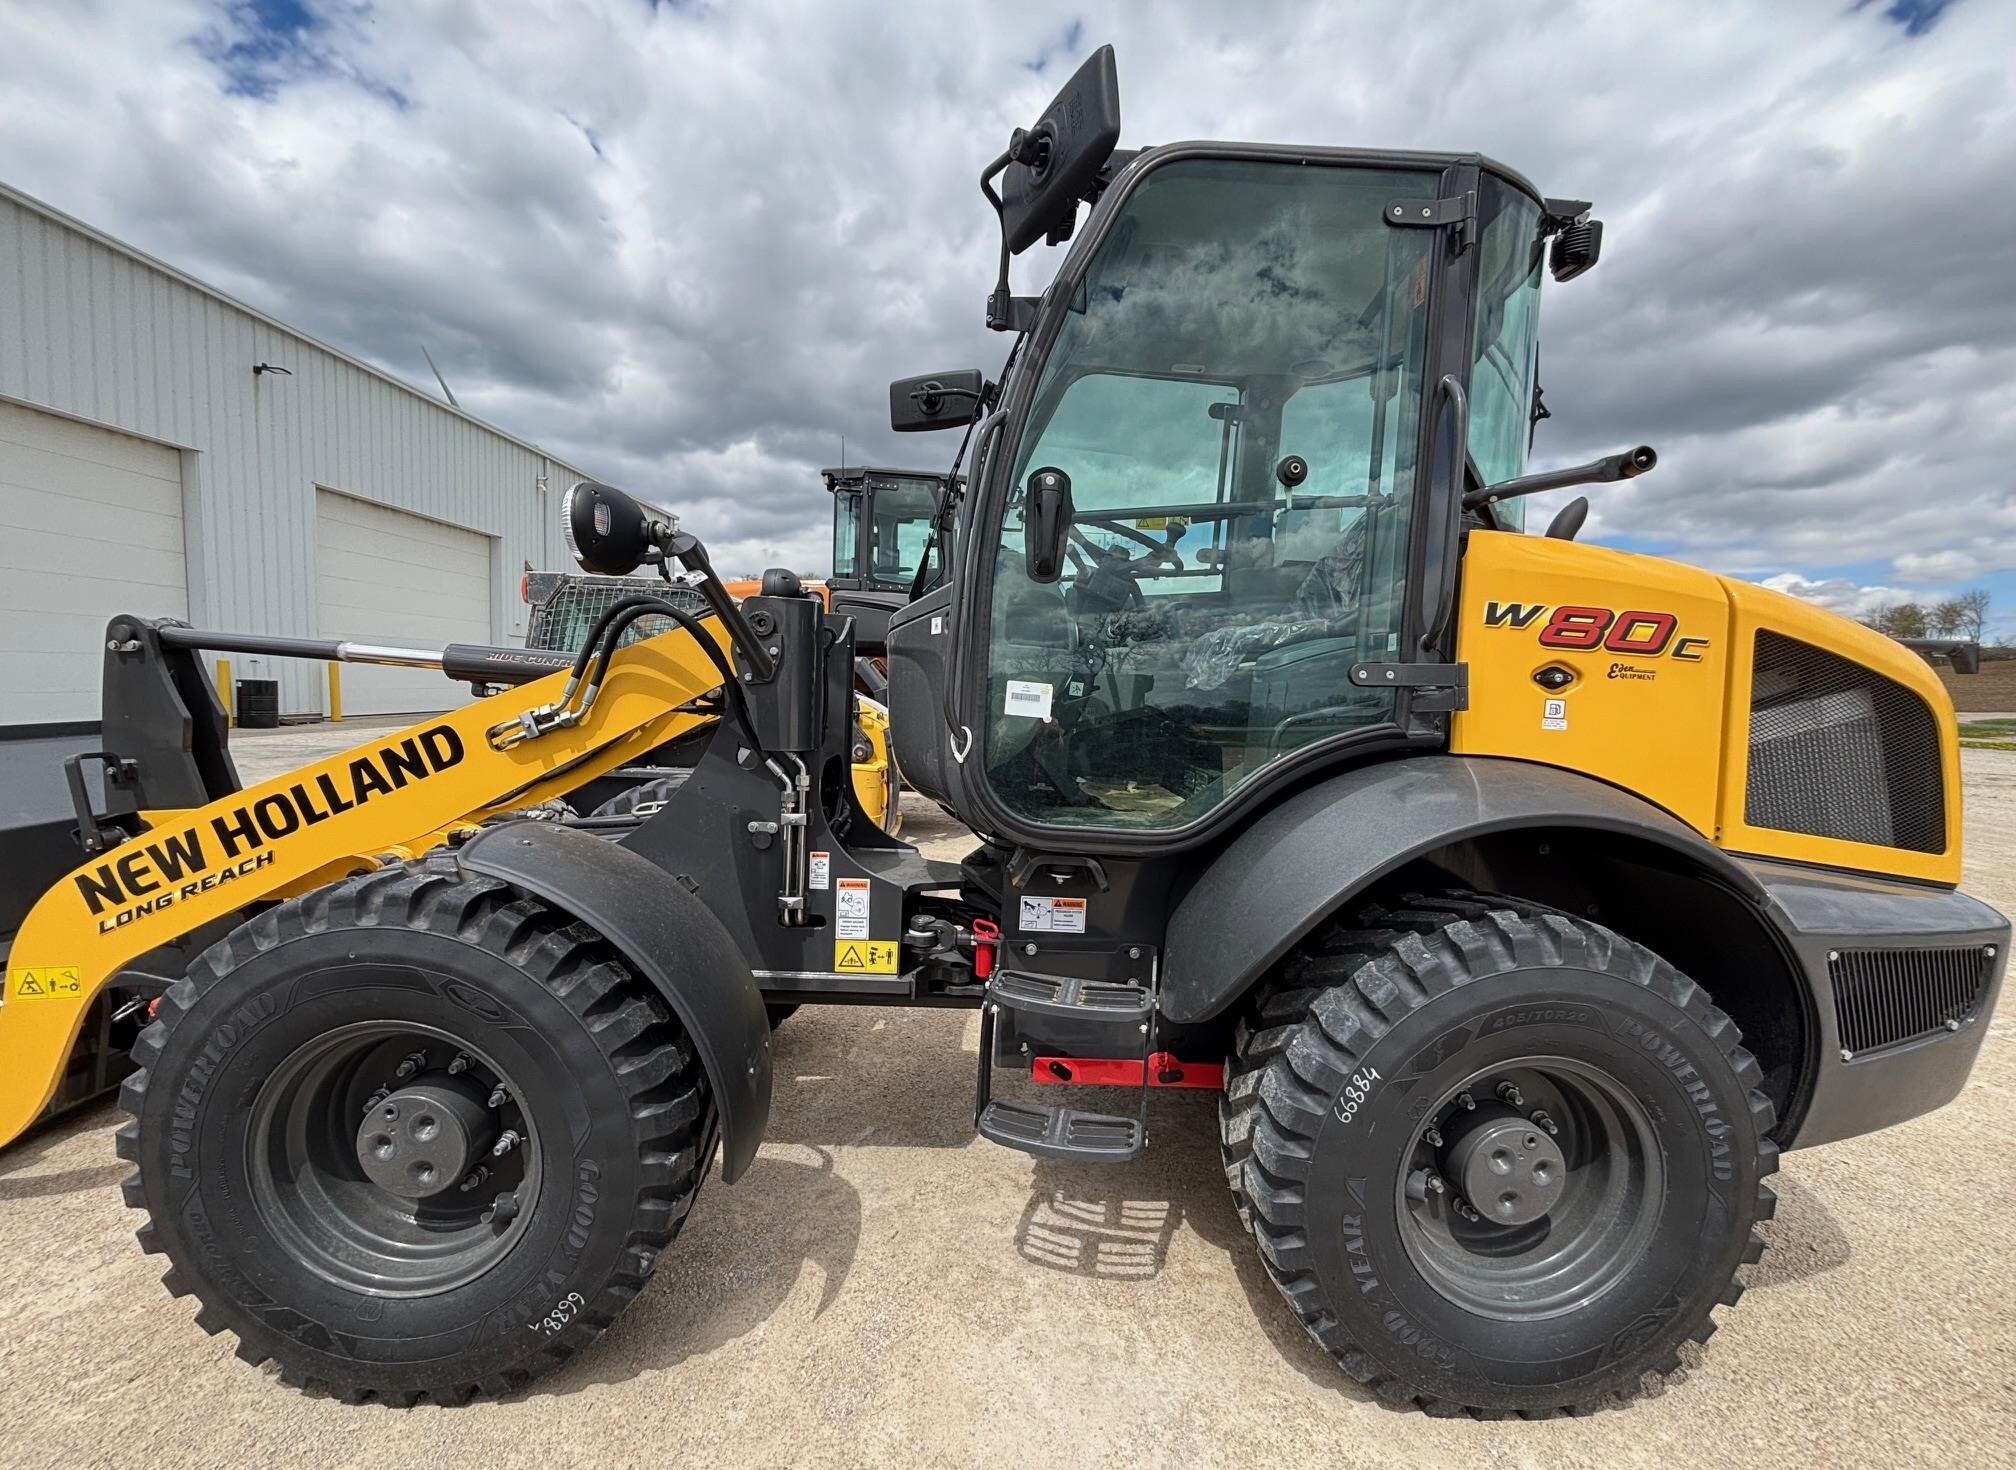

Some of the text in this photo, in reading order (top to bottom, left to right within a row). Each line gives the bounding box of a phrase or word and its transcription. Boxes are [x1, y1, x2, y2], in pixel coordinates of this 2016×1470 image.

[74, 724, 465, 915] NEW HOLLAND
[99, 850, 275, 935] LONG REACH
[170, 991, 277, 1179] POWERLOAD
[1334, 1066, 1383, 1123] 66884
[1615, 1016, 1734, 1181] POWERLOAD
[1342, 1212, 1379, 1295] YEAR
